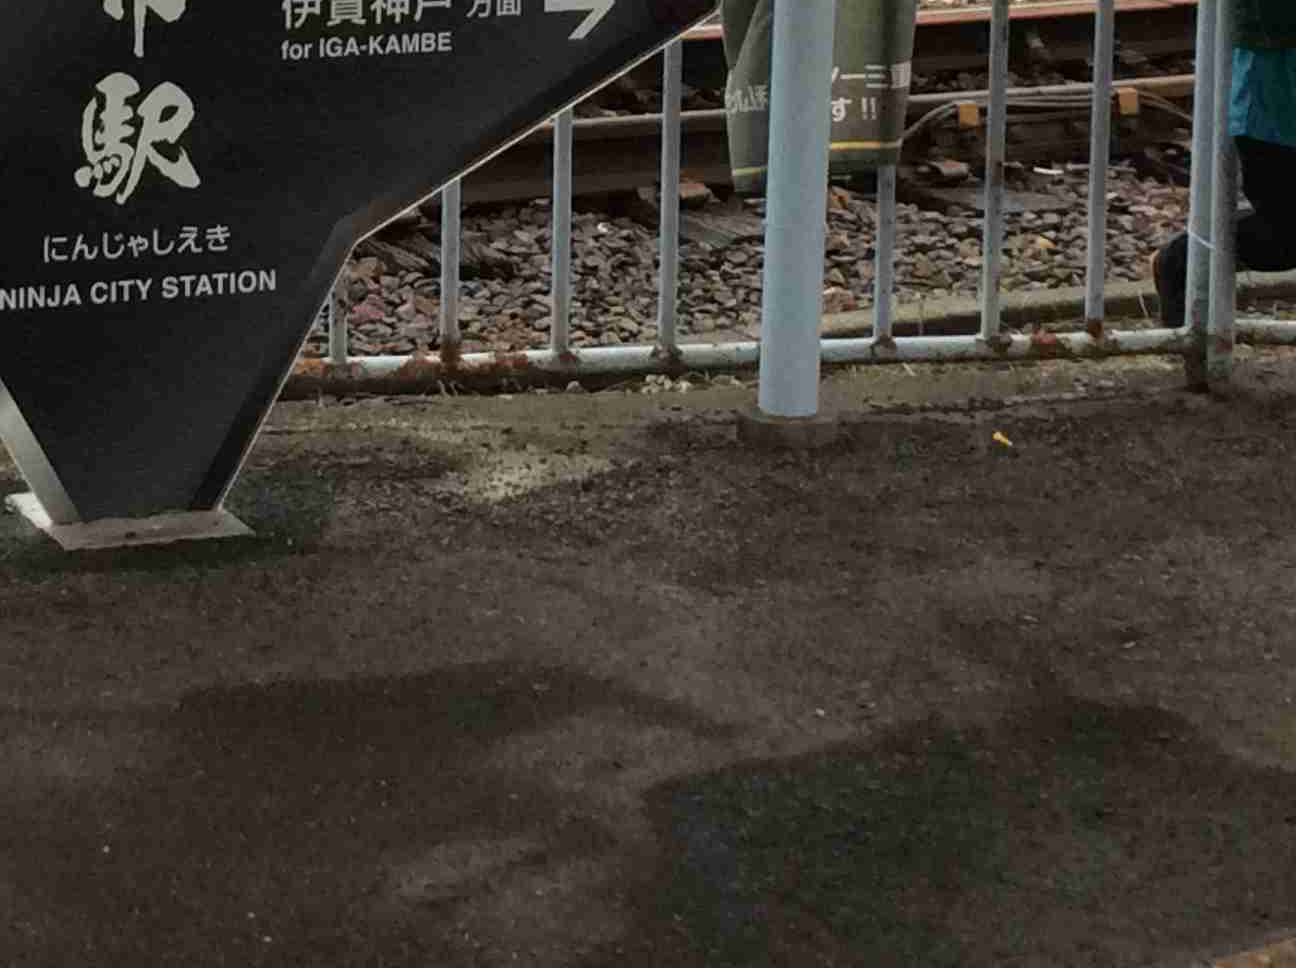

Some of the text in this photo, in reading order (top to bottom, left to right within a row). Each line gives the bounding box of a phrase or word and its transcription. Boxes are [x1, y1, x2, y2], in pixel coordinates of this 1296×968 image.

[281, 32, 452, 60] for IGA-KAMBE
[43, 225, 231, 263] にんじゃしえき
[90, 278, 152, 304] CITY
[161, 269, 277, 299] STATION
